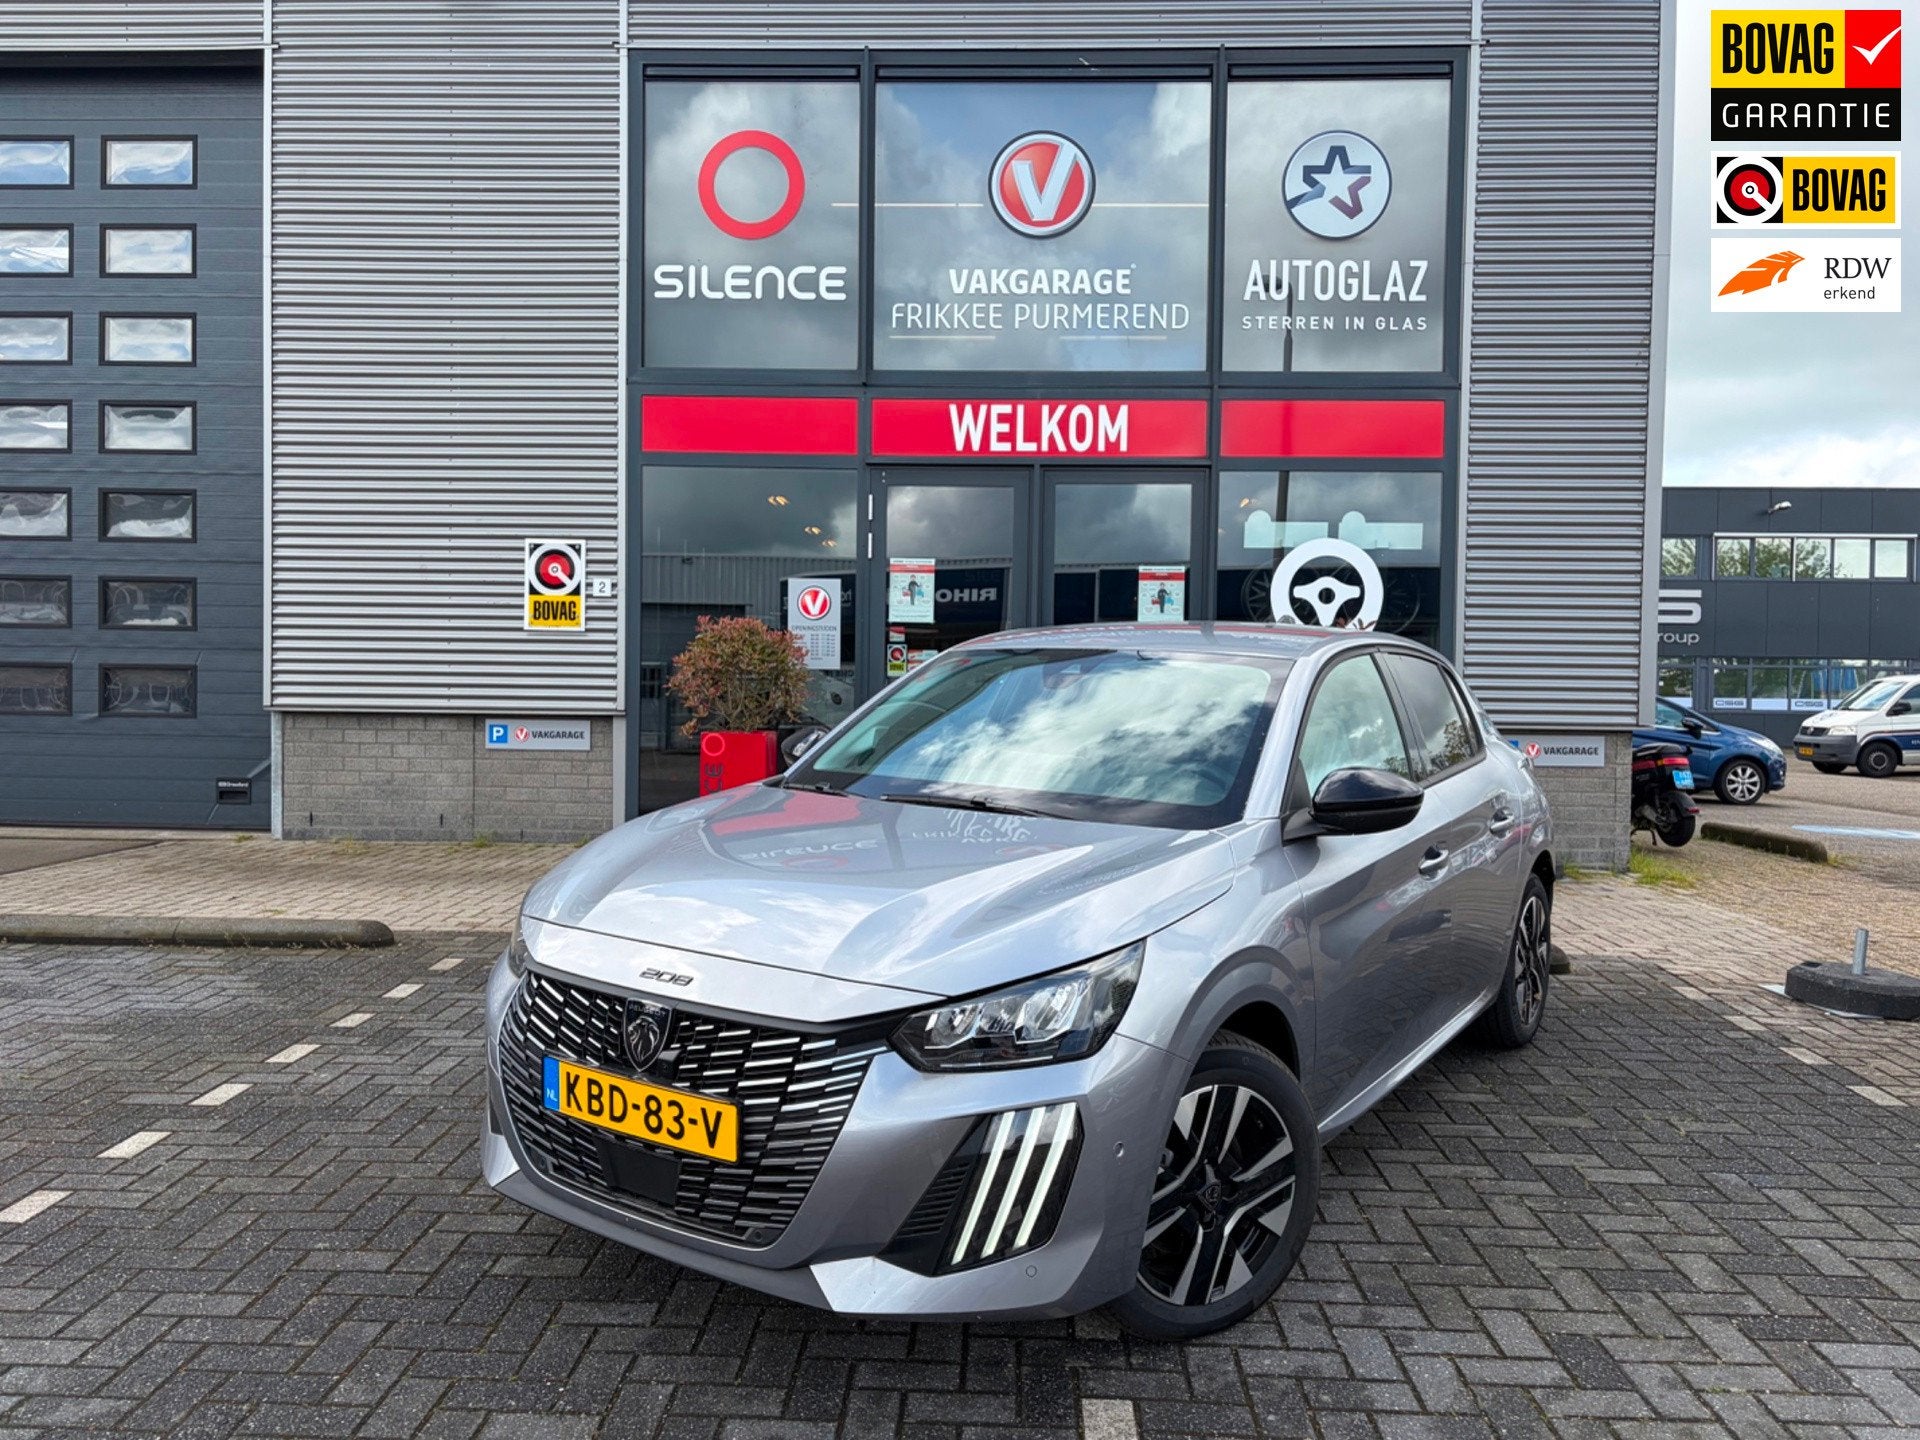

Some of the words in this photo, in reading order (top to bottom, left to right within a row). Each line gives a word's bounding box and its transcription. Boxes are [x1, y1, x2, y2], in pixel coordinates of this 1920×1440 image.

[654, 264, 848, 300] SILENCE
[949, 268, 1132, 295] VAKGARAGE
[1243, 259, 1429, 302] AUTOGLAZ
[892, 303, 1003, 329] FRIKKEE
[1014, 303, 1189, 330] PURMEREND
[1241, 316, 1335, 330] STERREN
[1345, 317, 1365, 330] IN
[1375, 317, 1428, 331] GLAS
[948, 404, 1129, 452] WELKOM
[598, 581, 606, 593] 2
[533, 600, 577, 621] BOVAG
[1658, 632, 1700, 645] roup
[492, 727, 505, 741] P
[531, 730, 585, 739] VAKGARAGE
[1543, 746, 1599, 756] VAKGARAGE
[639, 968, 694, 987] 208
[546, 1087, 558, 1101] NL
[565, 1071, 723, 1149] KBD-83-V
